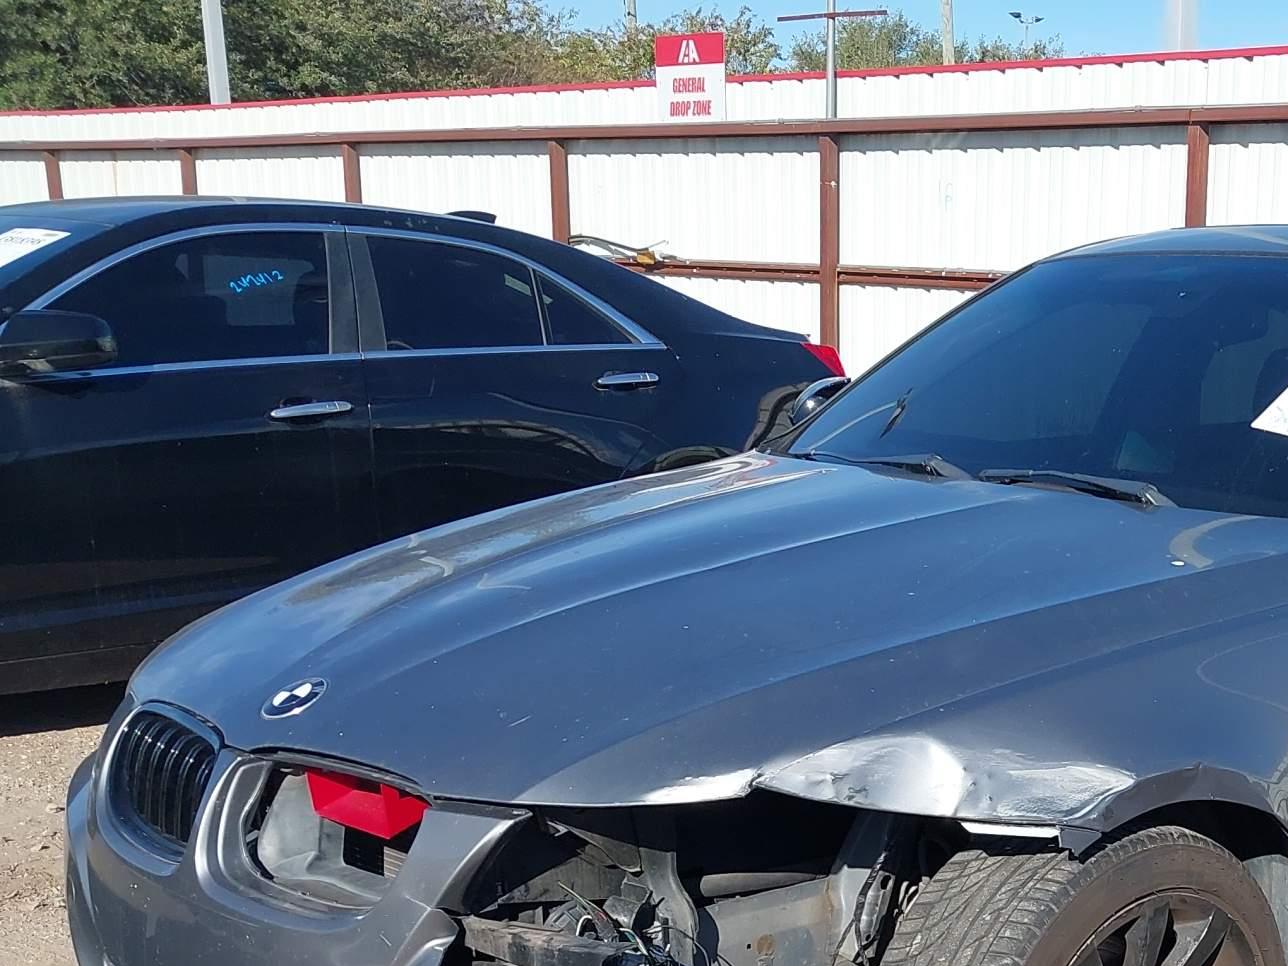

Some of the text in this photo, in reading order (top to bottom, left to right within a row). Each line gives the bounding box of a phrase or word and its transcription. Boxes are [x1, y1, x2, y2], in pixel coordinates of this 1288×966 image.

[672, 77, 706, 93] GENERAL
[670, 100, 712, 117] DROP ZONE
